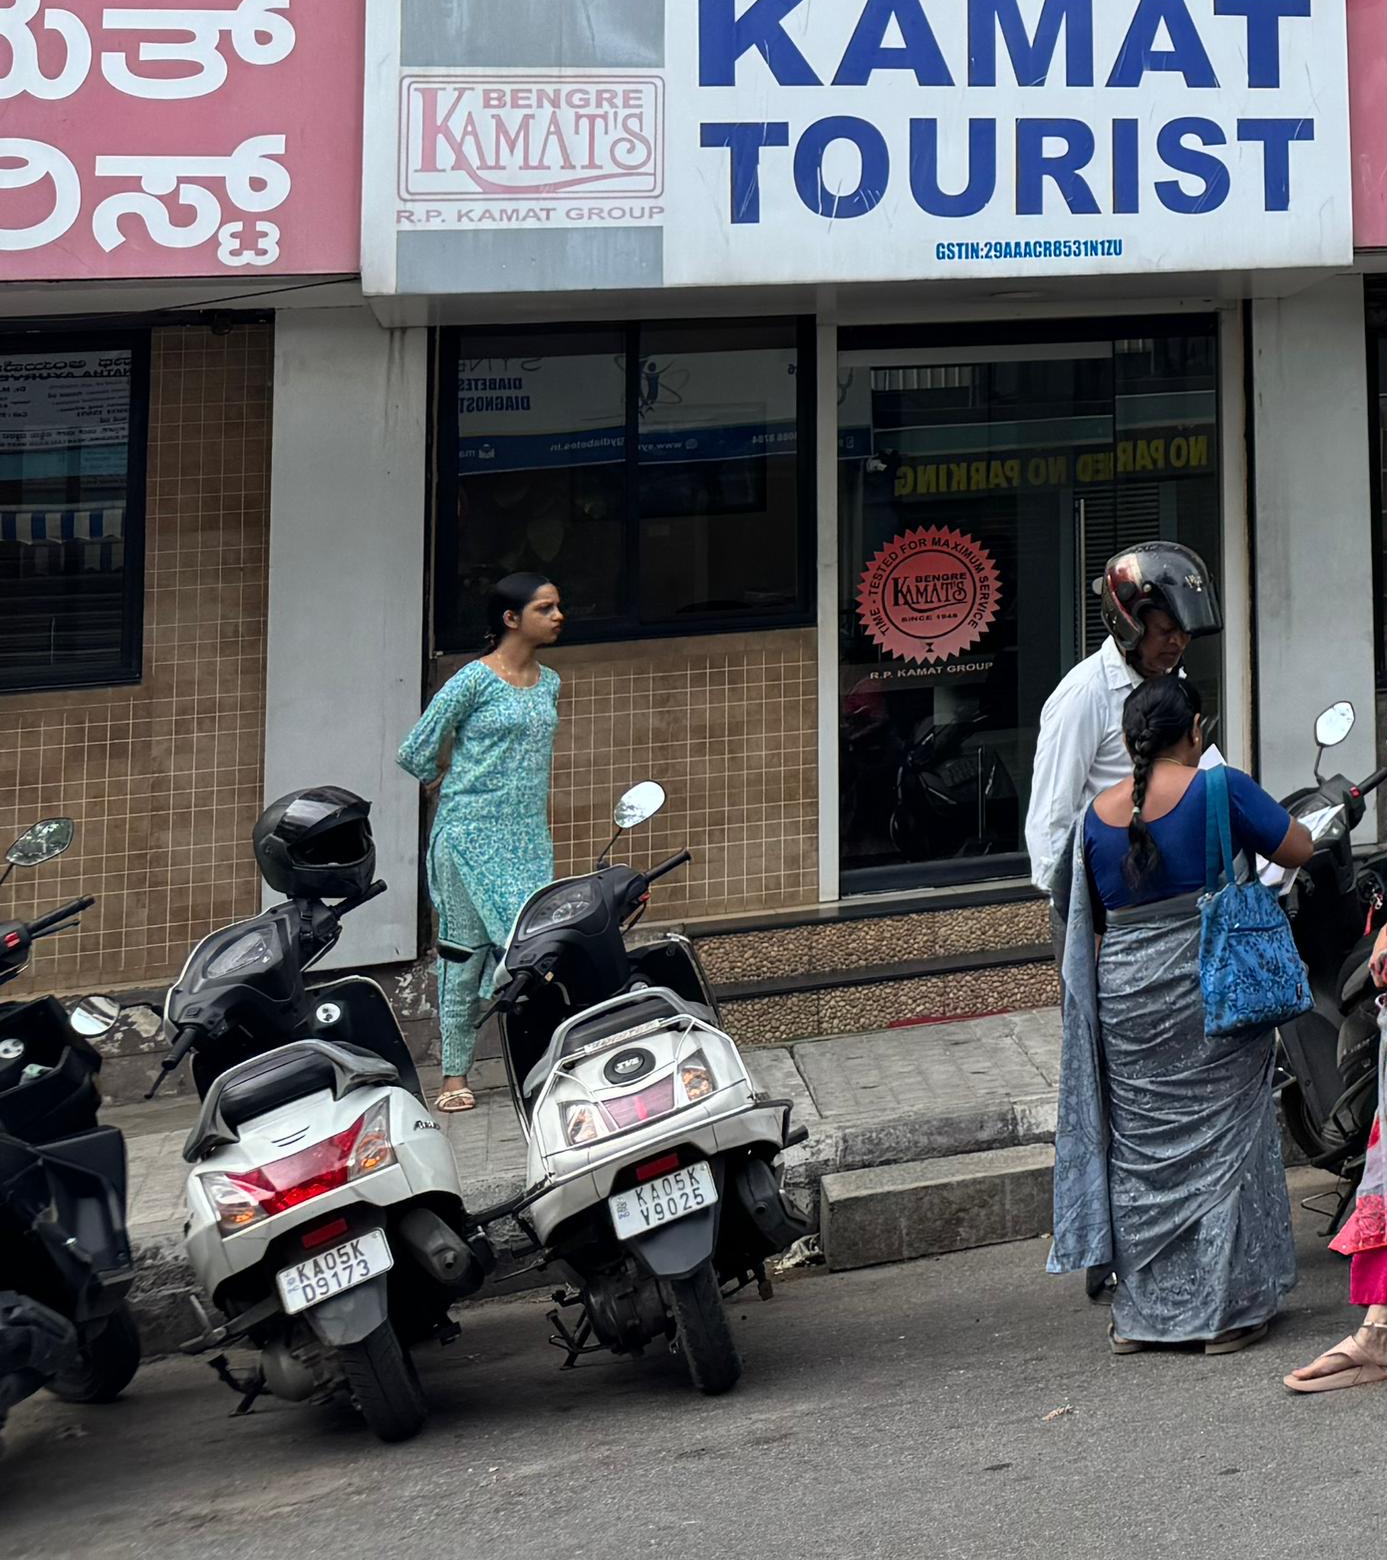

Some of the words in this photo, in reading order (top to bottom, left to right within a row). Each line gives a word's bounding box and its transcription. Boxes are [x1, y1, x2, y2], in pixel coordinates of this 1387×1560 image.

[482, 88, 643, 110] BENGRE
[413, 86, 655, 190] KAMAT'S
[698, 114, 1315, 225] TOURIST
[396, 209, 446, 226] R.P.
[456, 207, 557, 223] KAMAT
[565, 205, 665, 221] GROUP
[899, 537, 928, 555] FOR
[931, 536, 986, 574] MAXIMUM
[867, 551, 899, 598] TESTED
[890, 575, 969, 612] KAMAT'S
[914, 571, 968, 584] BENGRE
[967, 574, 991, 630] SERVICE
[869, 606, 890, 637] TIME
[897, 665, 944, 678] KAMAT
[946, 661, 994, 673] GROUP
[615, 1056, 641, 1070] TVS
[634, 1166, 702, 1208] KA05K
[639, 1186, 705, 1227] V9025
[296, 1238, 366, 1284] KA05K
[301, 1258, 371, 1304] D9173
